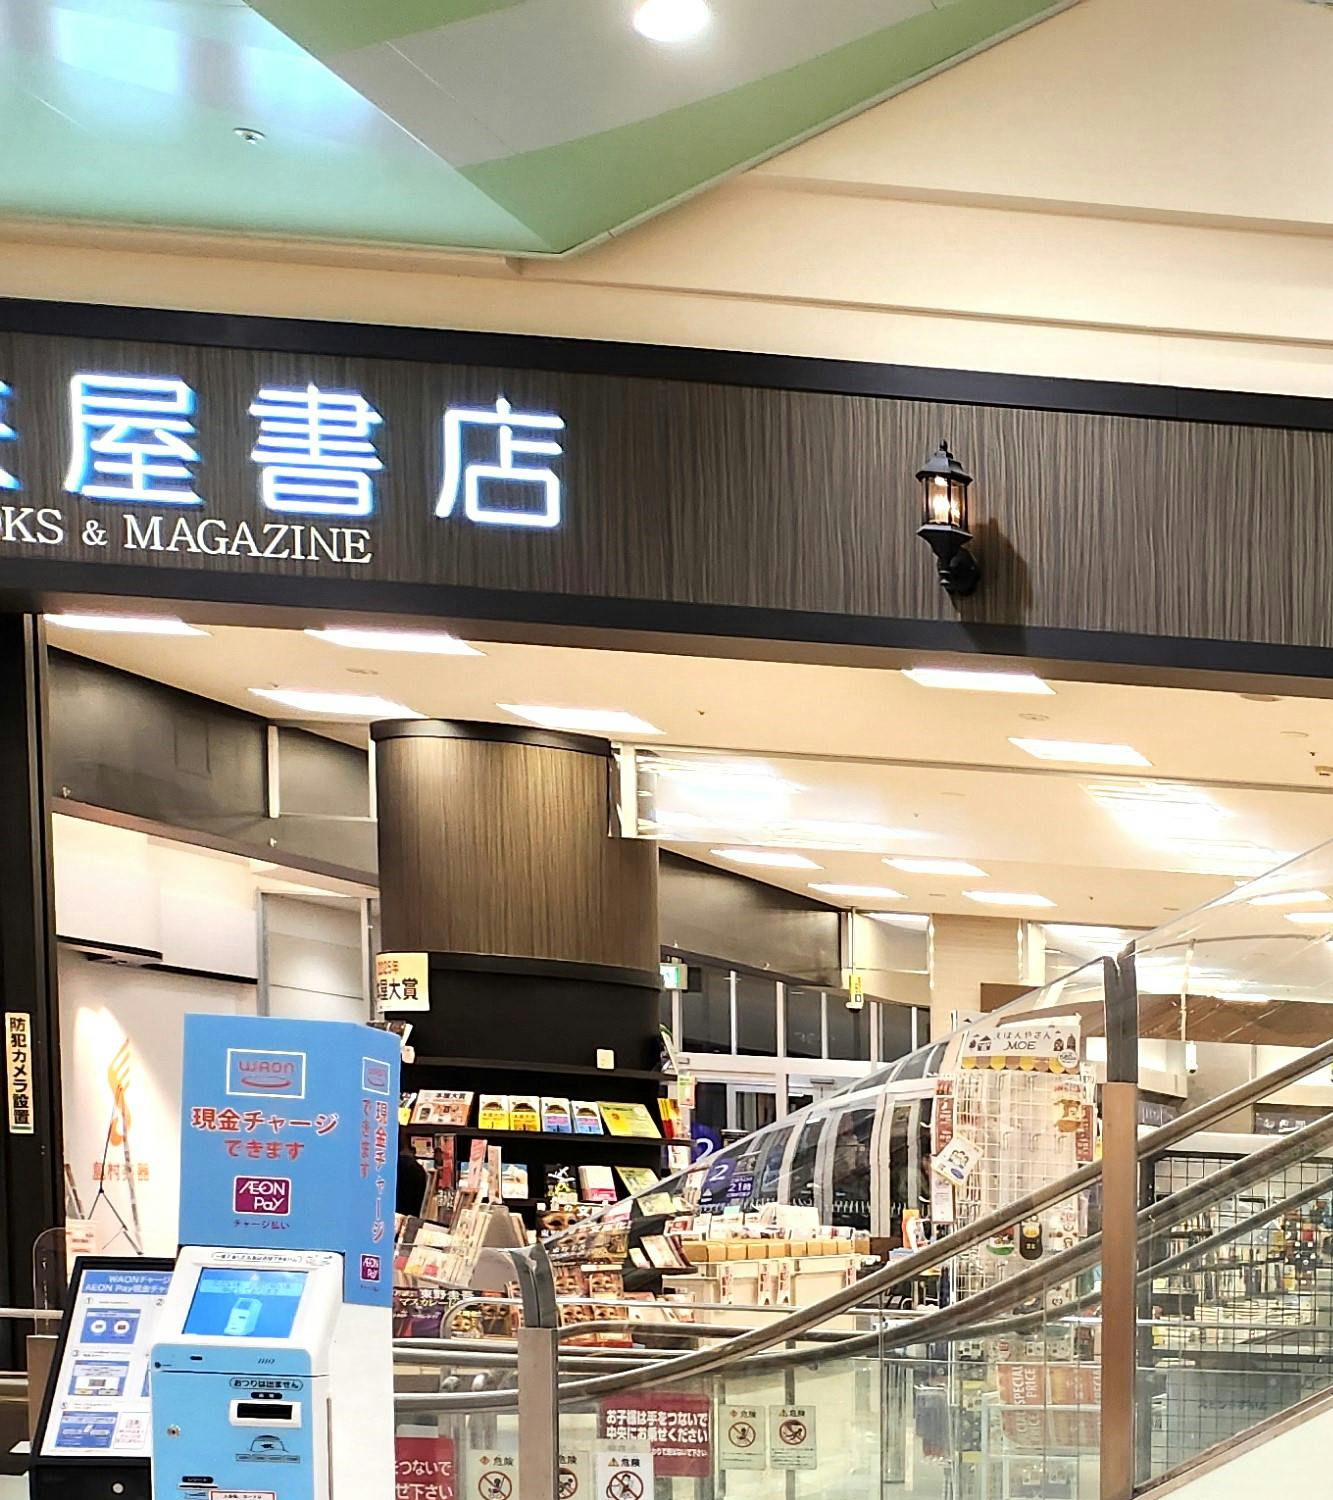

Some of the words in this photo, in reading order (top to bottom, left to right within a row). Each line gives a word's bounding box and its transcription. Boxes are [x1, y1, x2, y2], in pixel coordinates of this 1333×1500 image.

[0, 372, 566, 530] 屋書店
[0, 507, 64, 545] KS
[82, 518, 108, 547] &
[123, 513, 374, 565] MAGAZINE
[1003, 1040, 1037, 1051] MOE
[9, 1017, 31, 1125] 防犯カメラ設置
[191, 1106, 339, 1136] 現金チャージ
[224, 1139, 305, 1161] できます
[371, 1101, 388, 1243] 現金チャージ
[253, 1196, 285, 1212] Pay
[1025, 1368, 1037, 1398] PRICE
